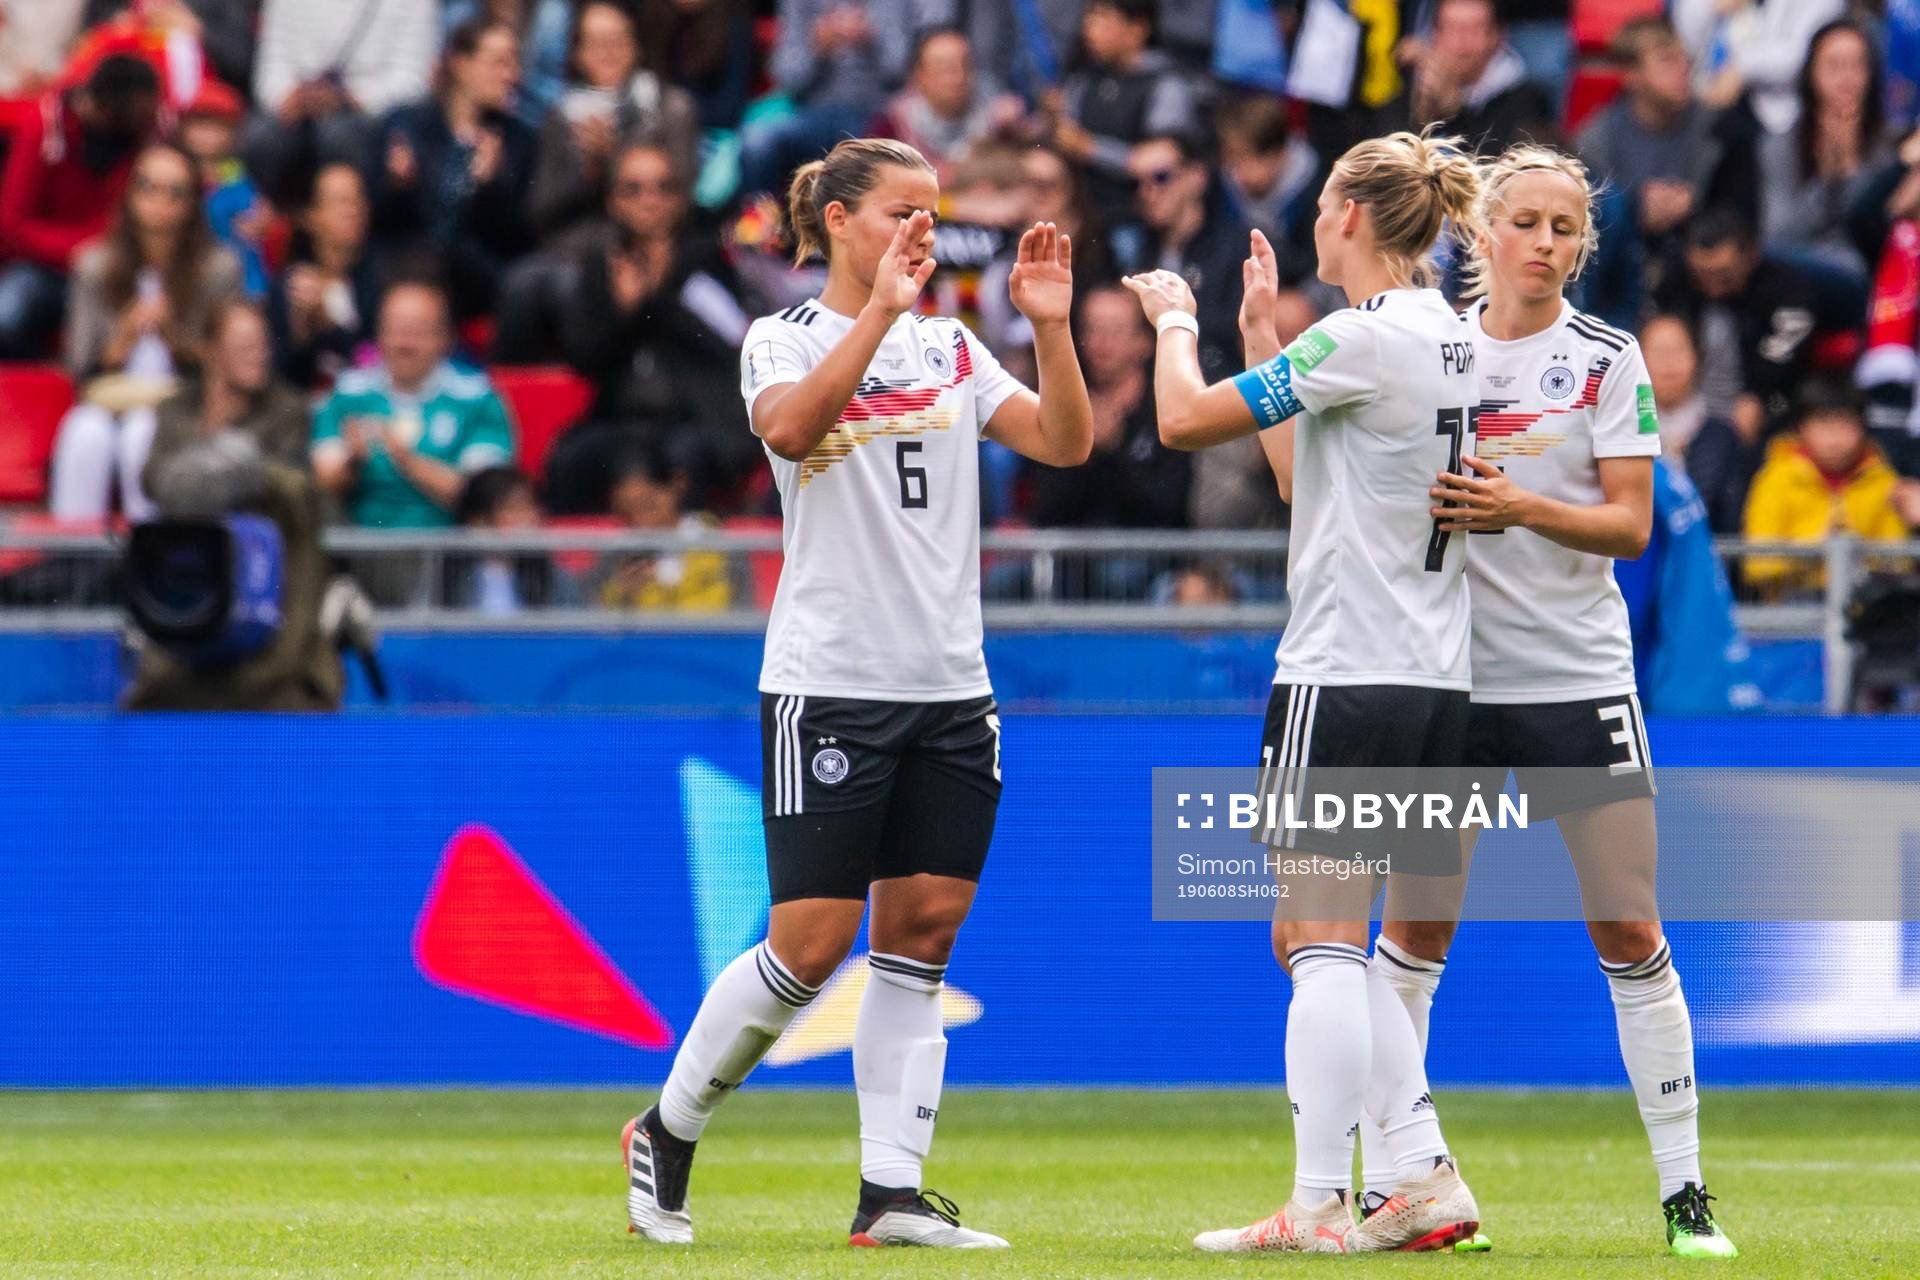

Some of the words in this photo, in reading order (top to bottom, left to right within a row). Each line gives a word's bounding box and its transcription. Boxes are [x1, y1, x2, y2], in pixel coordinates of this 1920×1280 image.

[1259, 396, 1279, 423] FIFA
[896, 441, 928, 509] 6
[1597, 703, 1642, 777] 3
[1661, 1075, 1692, 1095] DFB
